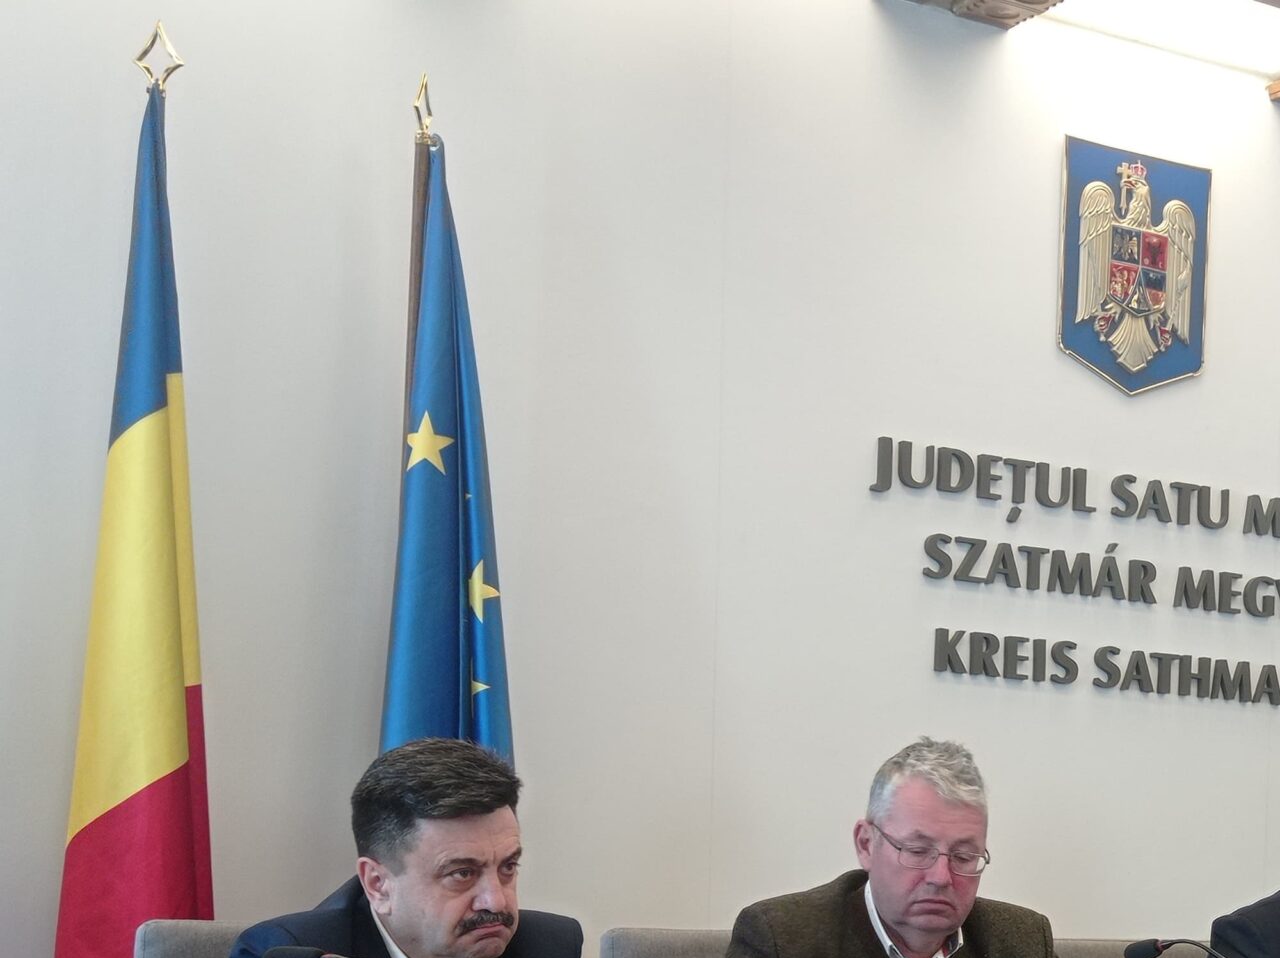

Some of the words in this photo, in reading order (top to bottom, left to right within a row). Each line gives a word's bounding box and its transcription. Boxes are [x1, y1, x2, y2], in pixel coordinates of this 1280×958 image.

[869, 436, 1096, 524] JUDEȚUL
[1110, 474, 1229, 530] SATU
[922, 533, 1157, 605] SZATMÁR
[933, 627, 1079, 684] KREIS
